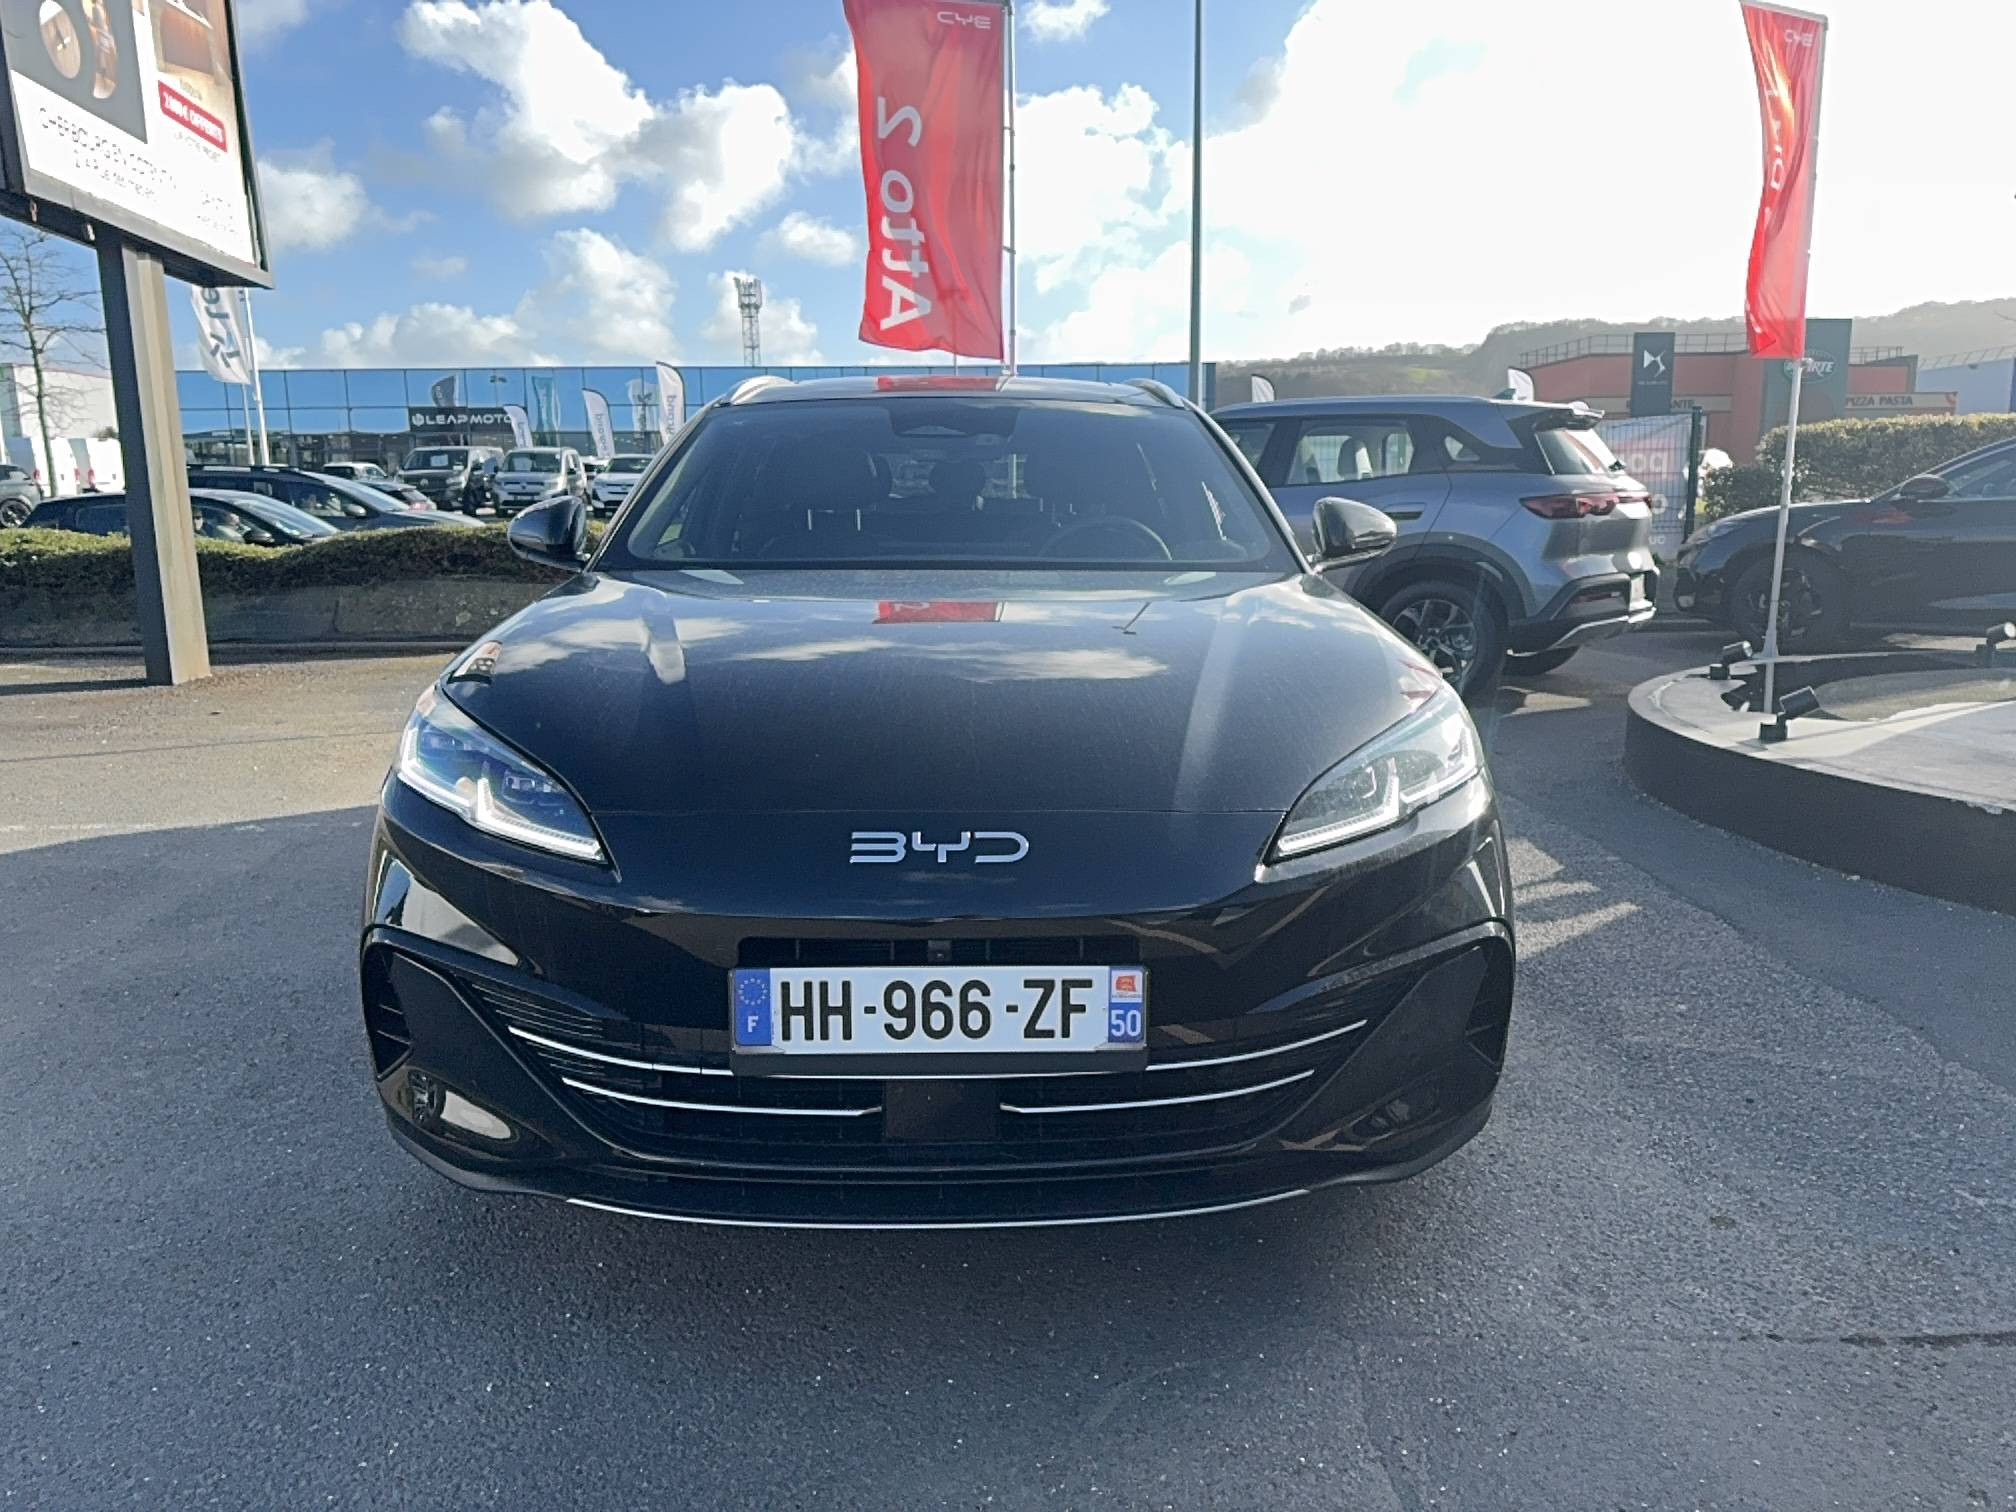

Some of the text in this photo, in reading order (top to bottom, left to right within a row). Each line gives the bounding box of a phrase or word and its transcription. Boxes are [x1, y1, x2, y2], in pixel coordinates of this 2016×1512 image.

[1879, 396, 1913, 406] PASTA
[426, 414, 513, 425] LEAPMOTO
[850, 831, 1030, 864] BYD
[780, 979, 1093, 1041] HH-966-ZF
[747, 1015, 759, 1033] F
[1110, 1009, 1142, 1037] 50
